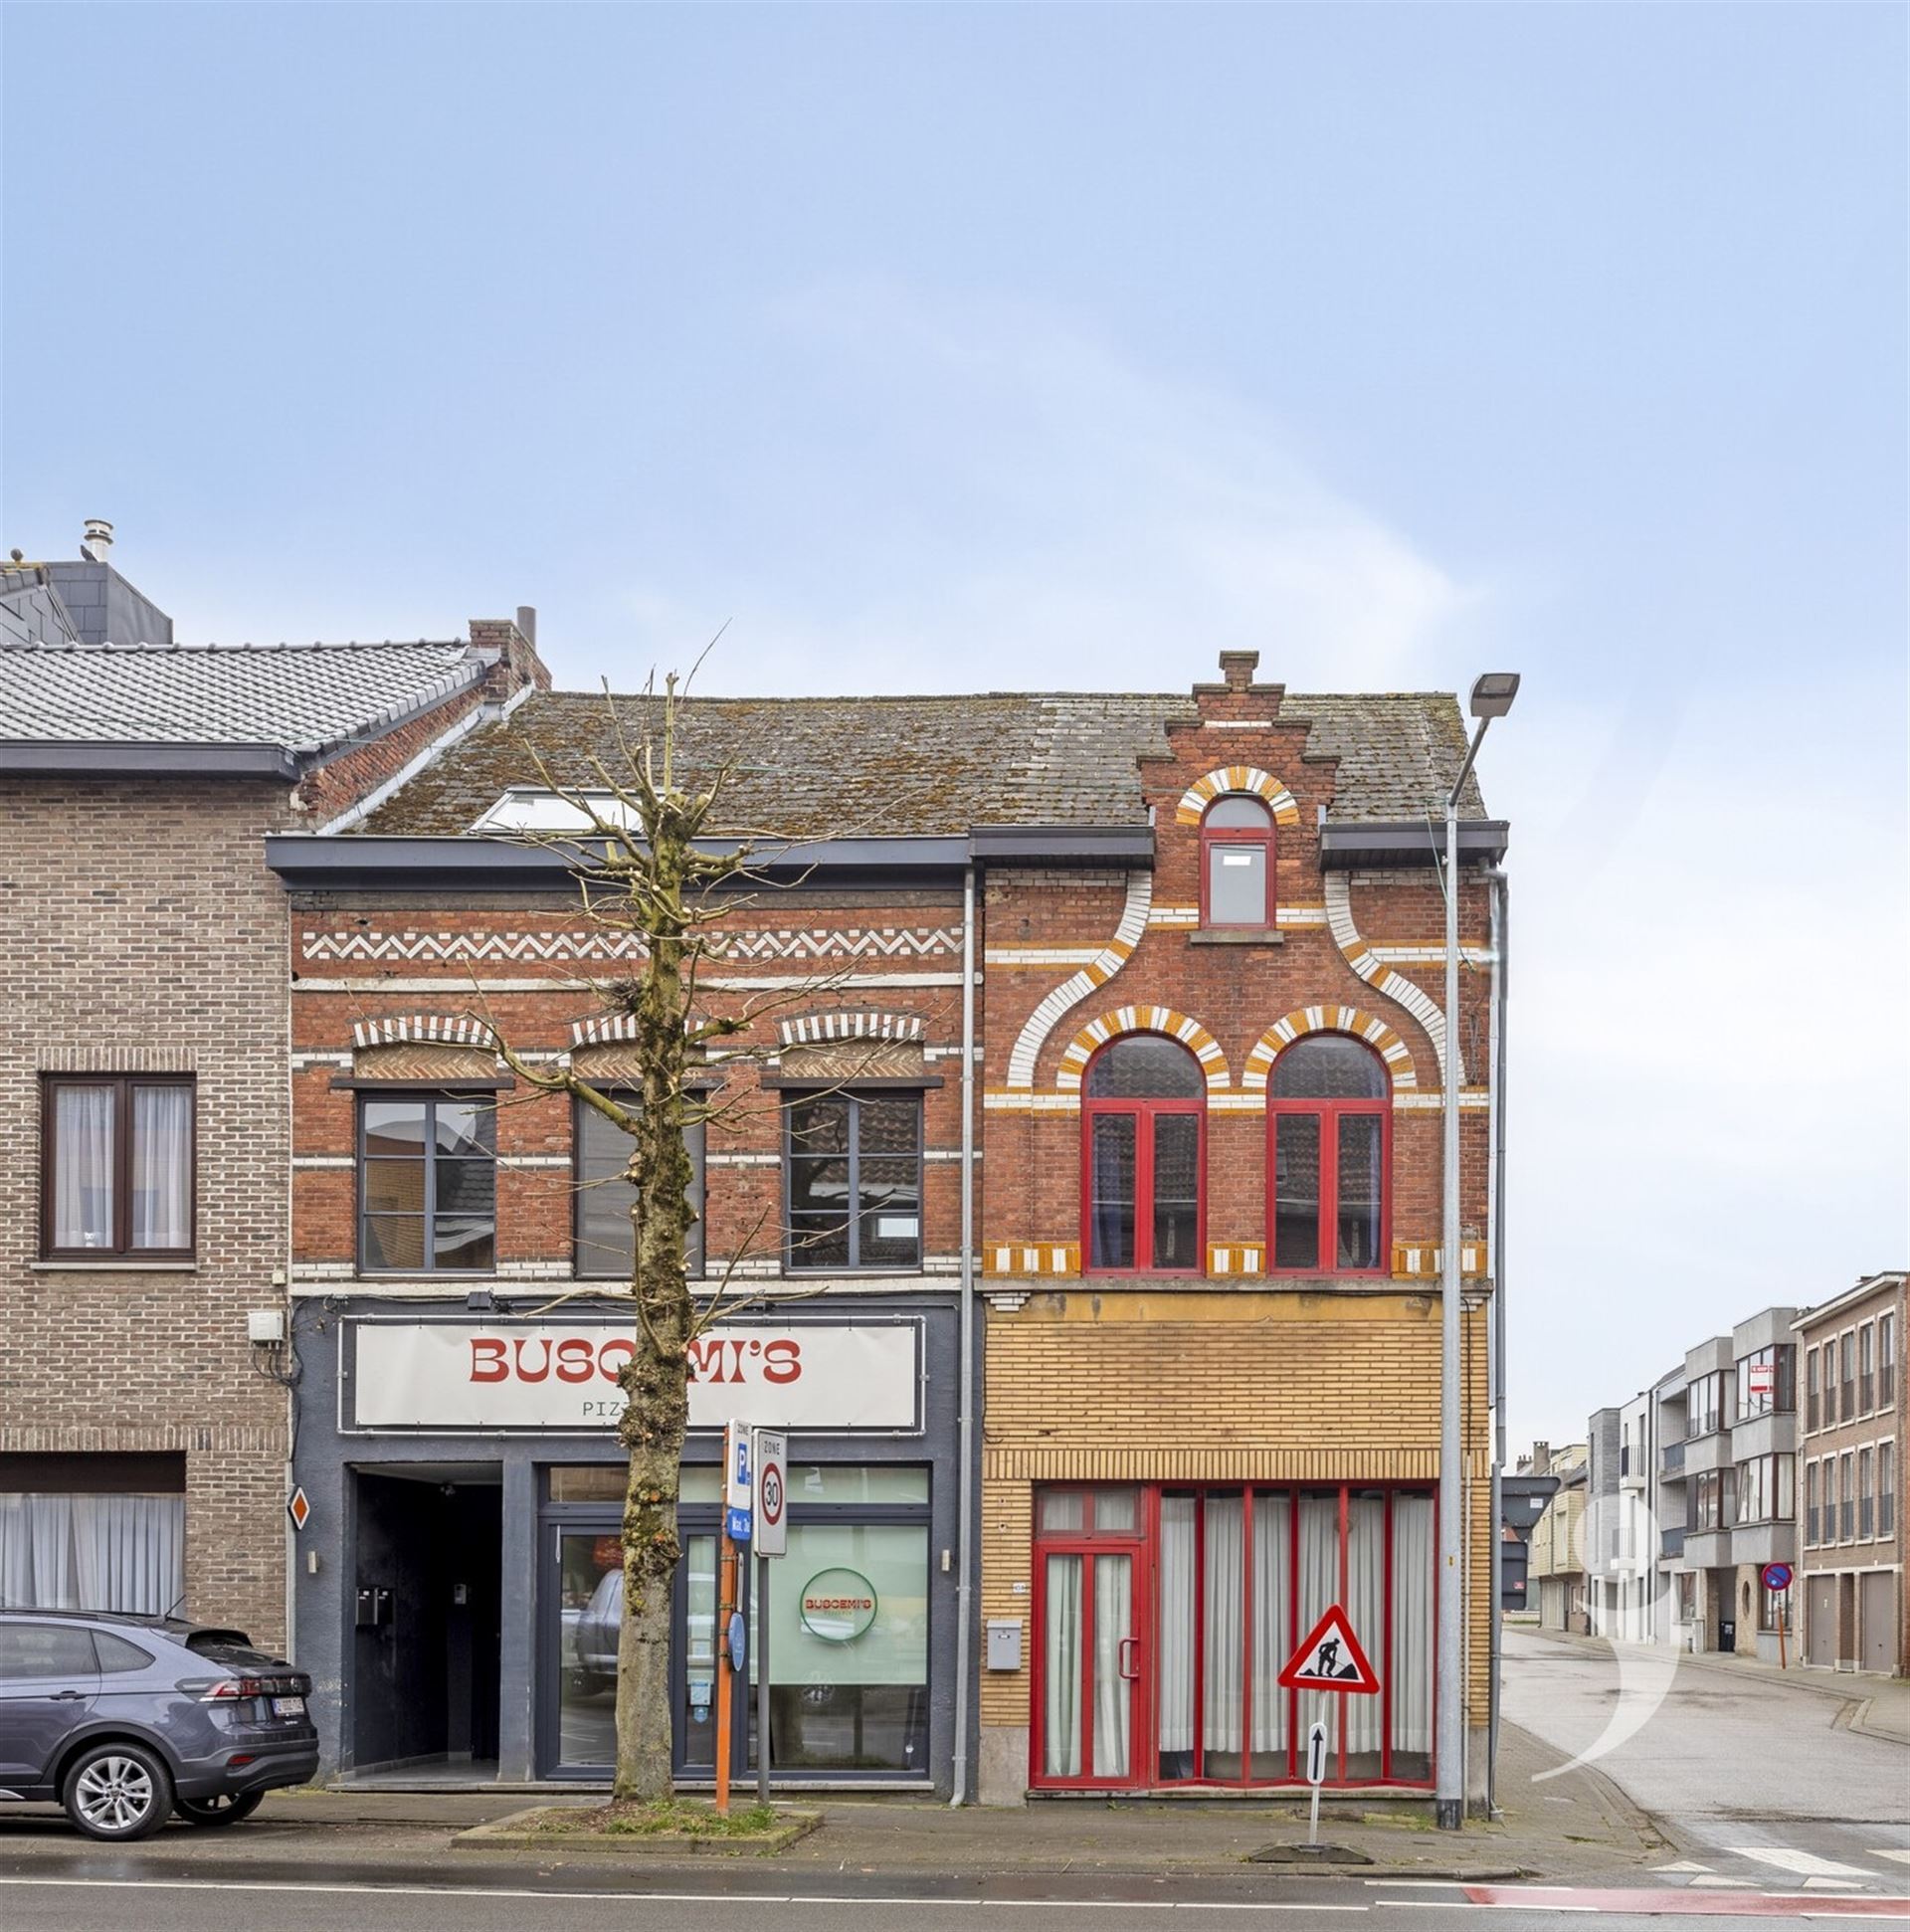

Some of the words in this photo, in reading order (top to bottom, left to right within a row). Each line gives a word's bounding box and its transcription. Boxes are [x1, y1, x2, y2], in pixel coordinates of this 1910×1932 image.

[470, 1338, 802, 1384] BUSCMI'S
[764, 1440, 780, 1455] ZONE
[765, 1480, 779, 1507] 30
[805, 1599, 872, 1610] BUSCEMI'S
